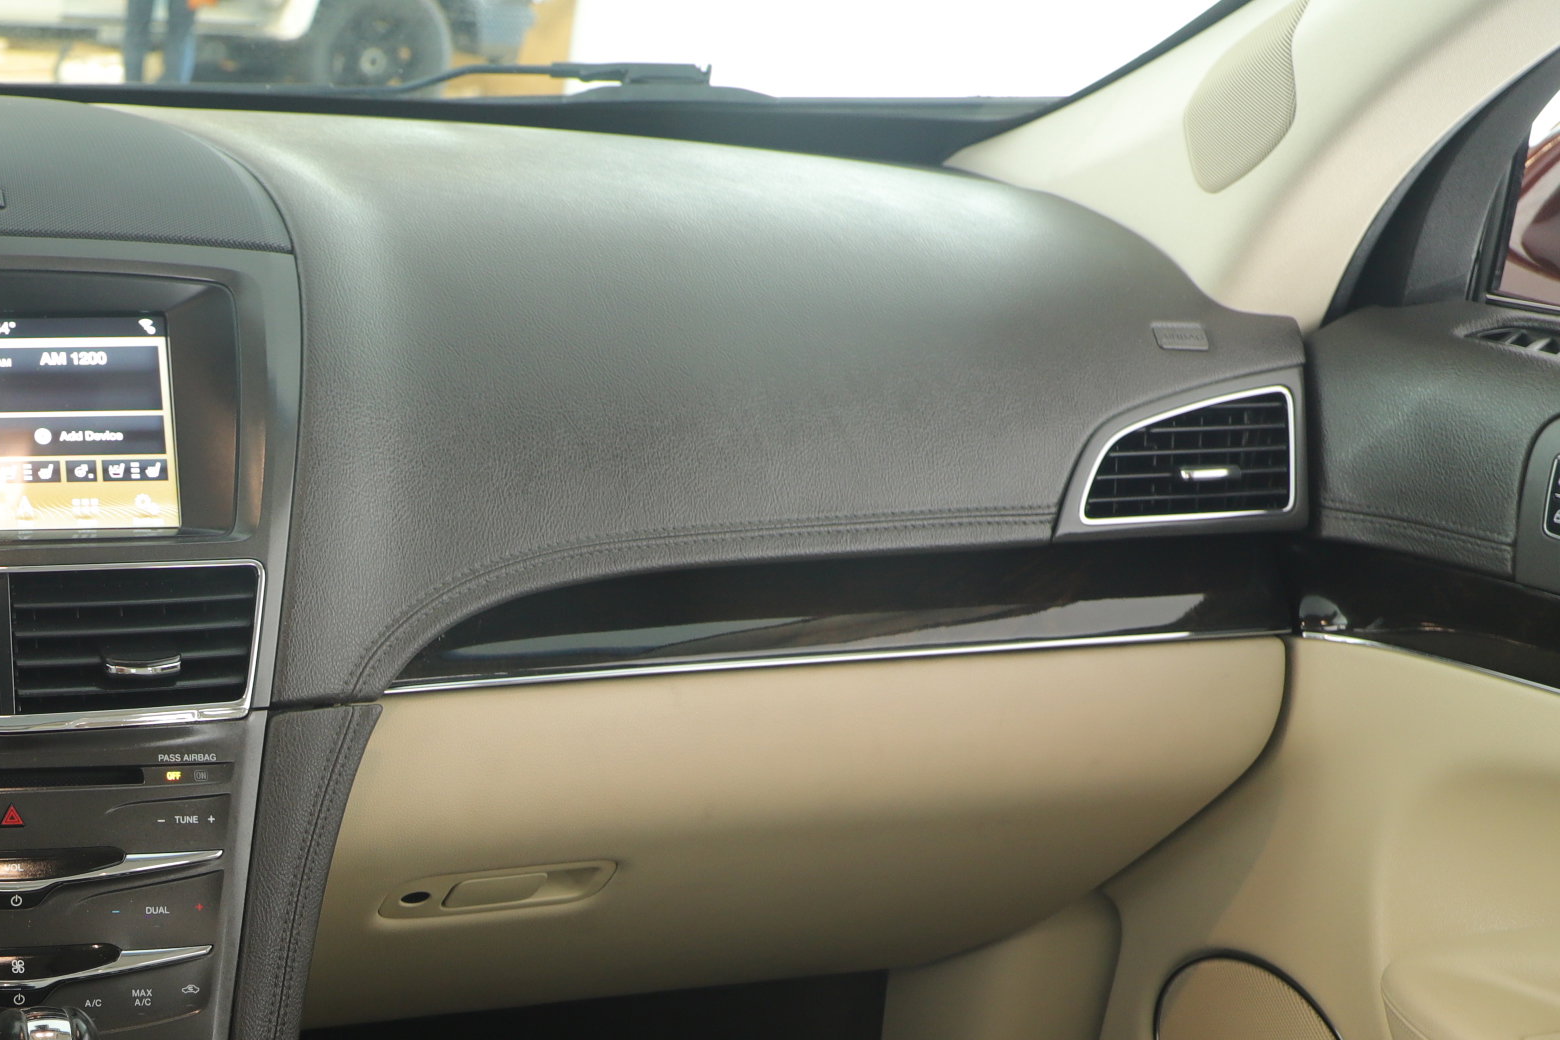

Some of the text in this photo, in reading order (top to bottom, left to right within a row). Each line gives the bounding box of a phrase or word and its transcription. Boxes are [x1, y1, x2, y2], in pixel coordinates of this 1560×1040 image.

[40, 351, 107, 365] AM 1200
[60, 431, 124, 441] Add Device
[158, 753, 217, 762] PASS AIRBAG
[166, 771, 207, 781] OFF ON
[174, 815, 199, 824] TUNE
[145, 906, 170, 915] DUAL
[132, 989, 153, 997] MAX
[84, 999, 102, 1008] A/C
[134, 998, 152, 1007] A/C
